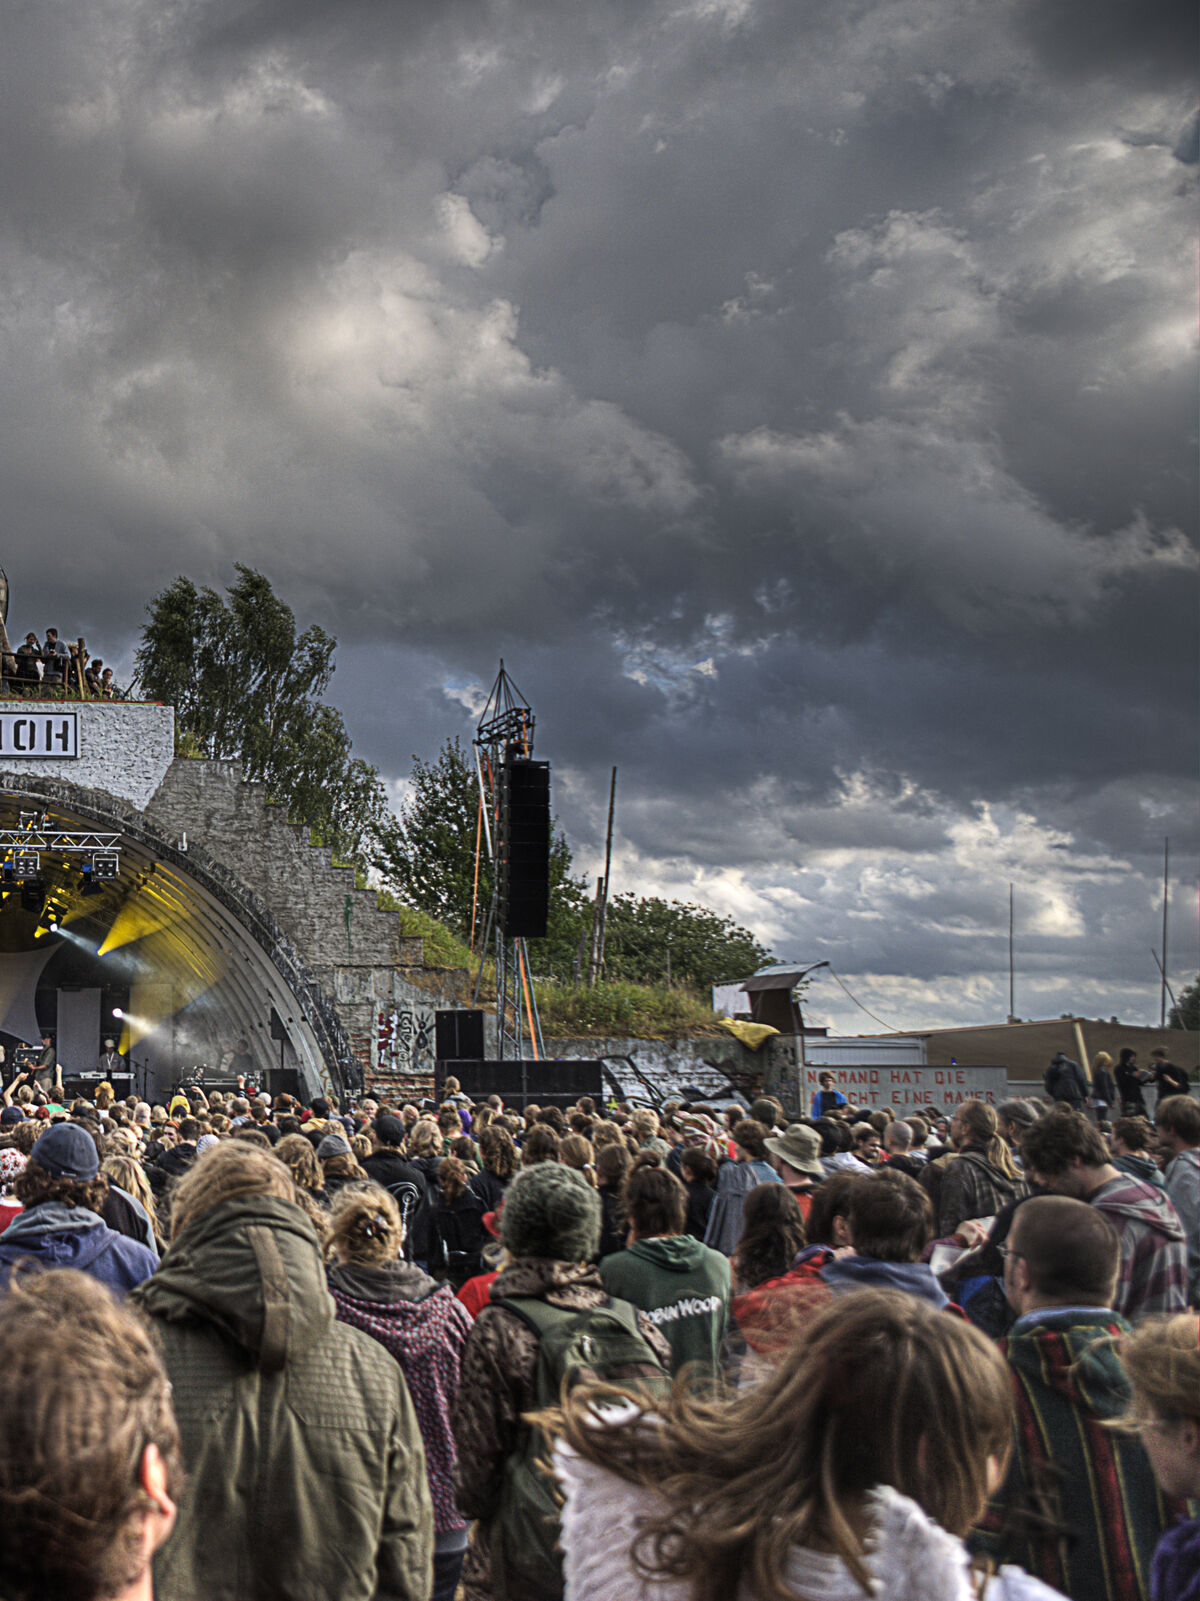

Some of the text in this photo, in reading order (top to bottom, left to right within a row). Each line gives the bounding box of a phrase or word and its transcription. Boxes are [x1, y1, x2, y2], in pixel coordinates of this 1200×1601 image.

[807, 1070, 966, 1085] NMAND HAT DIE
[891, 1090, 934, 1105] EINE
